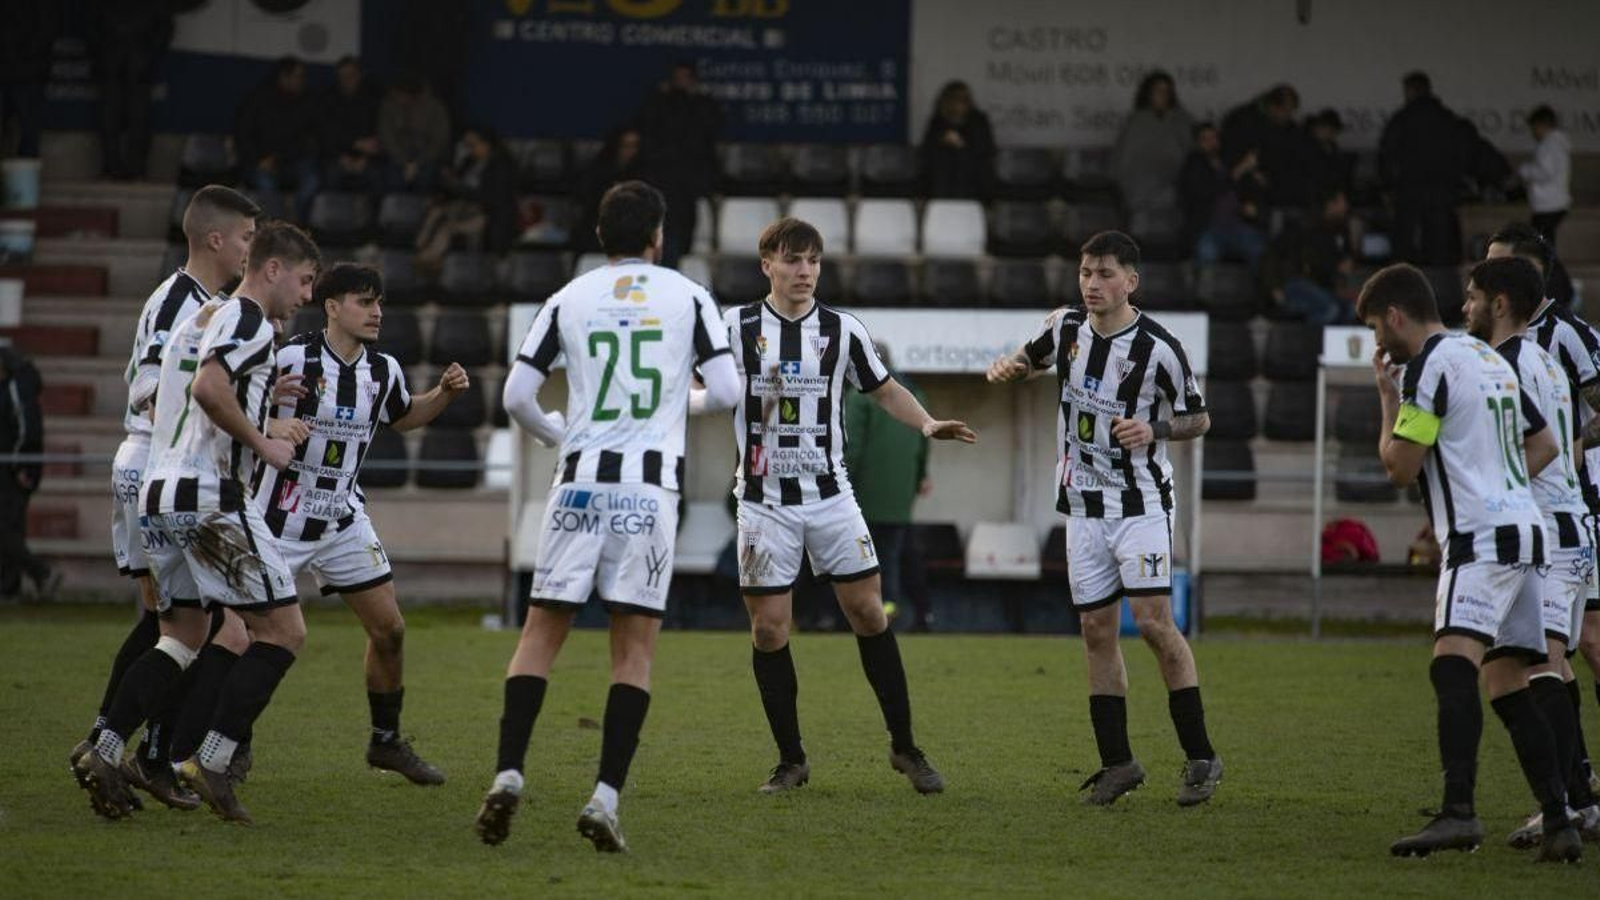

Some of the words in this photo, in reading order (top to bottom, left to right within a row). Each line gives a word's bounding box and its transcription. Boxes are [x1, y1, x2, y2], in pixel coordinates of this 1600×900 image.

[519, 21, 615, 44] CENTRO
[620, 23, 756, 48] COMERCIAL
[987, 26, 1108, 51] CASTRO
[1531, 65, 1598, 90] Móvil
[588, 330, 662, 421] 25
[1486, 397, 1527, 491] 10
